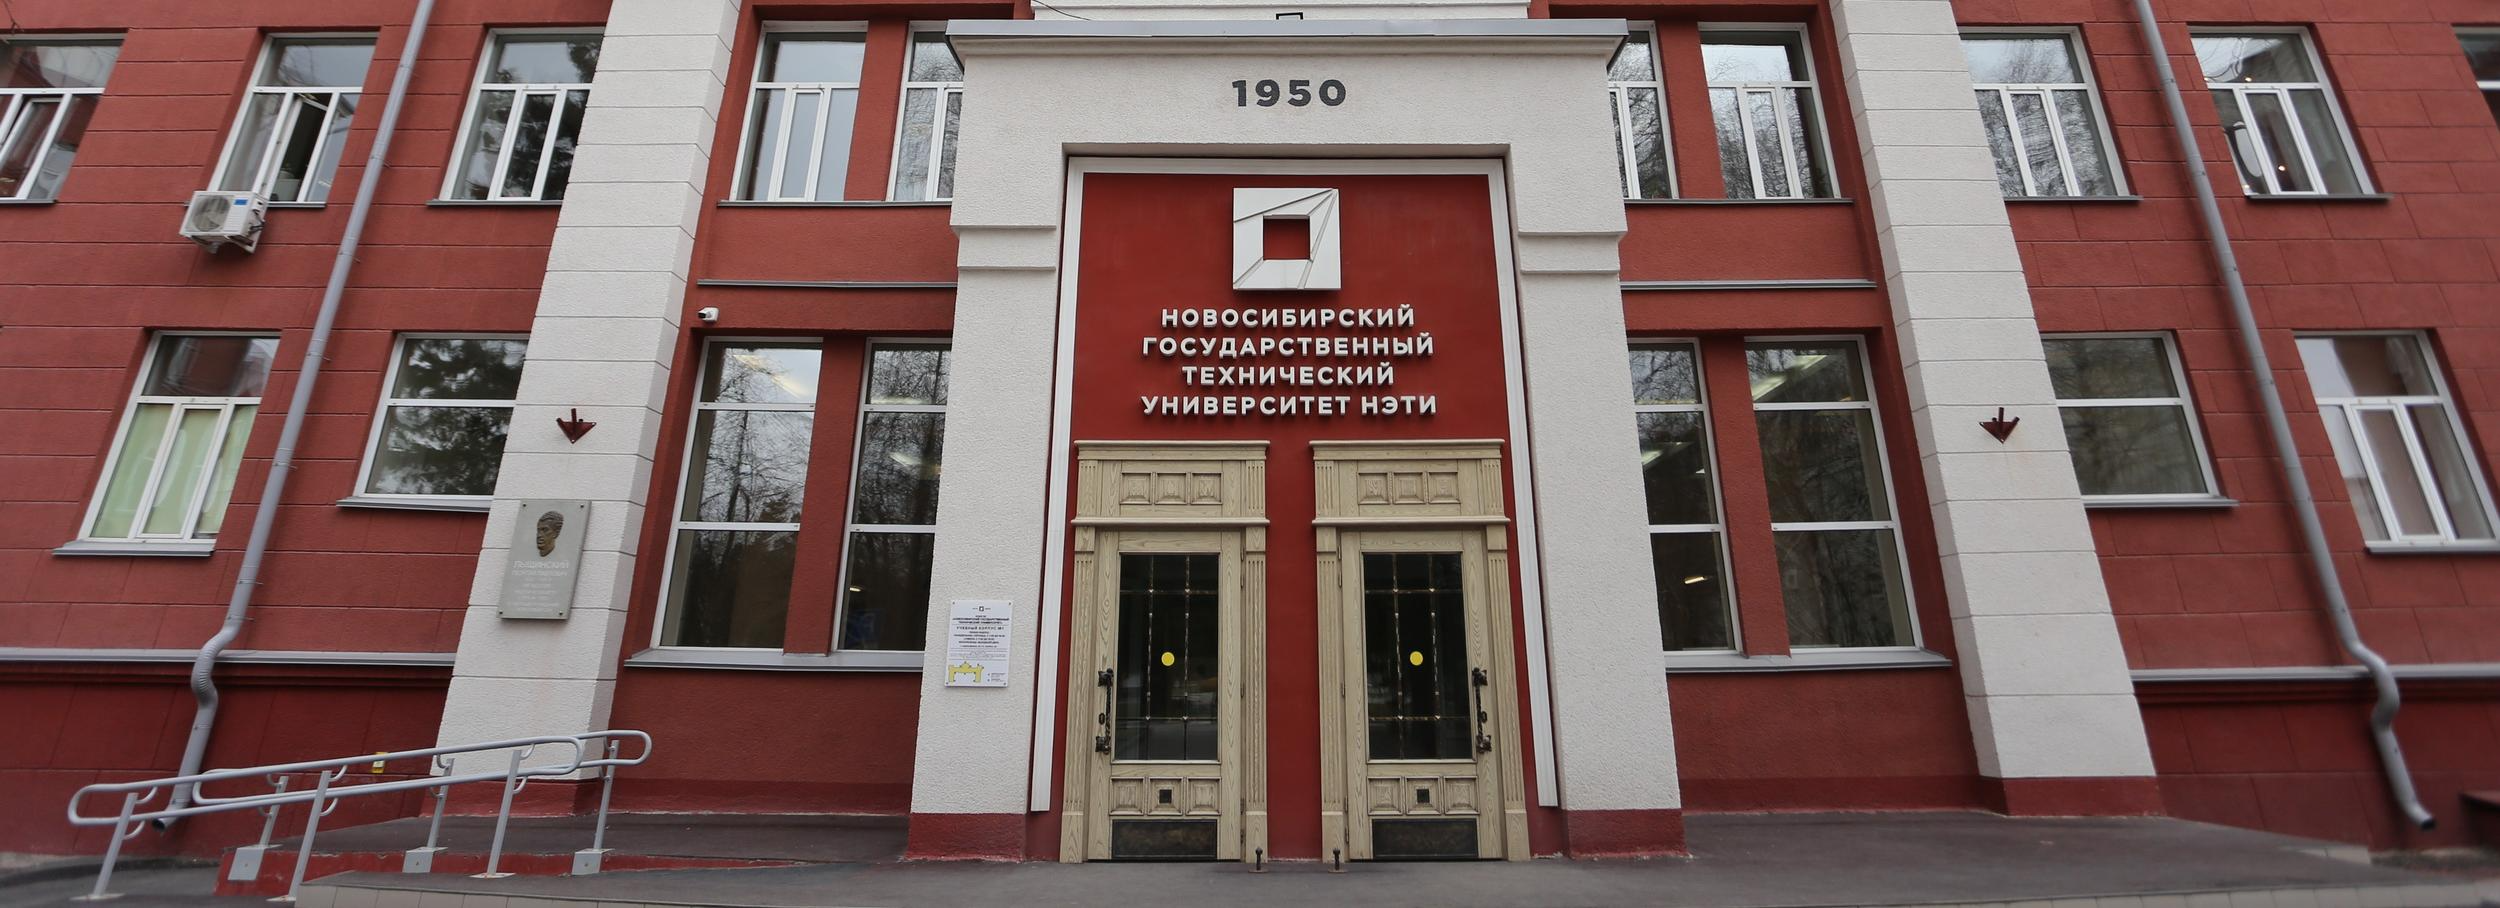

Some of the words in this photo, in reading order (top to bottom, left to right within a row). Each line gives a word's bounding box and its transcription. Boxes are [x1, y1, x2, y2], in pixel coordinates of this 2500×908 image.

[1232, 79, 1347, 108] 1950
[1161, 304, 1415, 328] НОВОСИБИРСКИЙ
[1142, 332, 1434, 359] ГОСУДАРСТВЕННЫЙ
[1182, 361, 1394, 385] ТЕХНИЧЕСКИЙ
[1140, 395, 1351, 416] УНИВЕРСИТЕТ
[1361, 395, 1437, 415] НЭТИ
